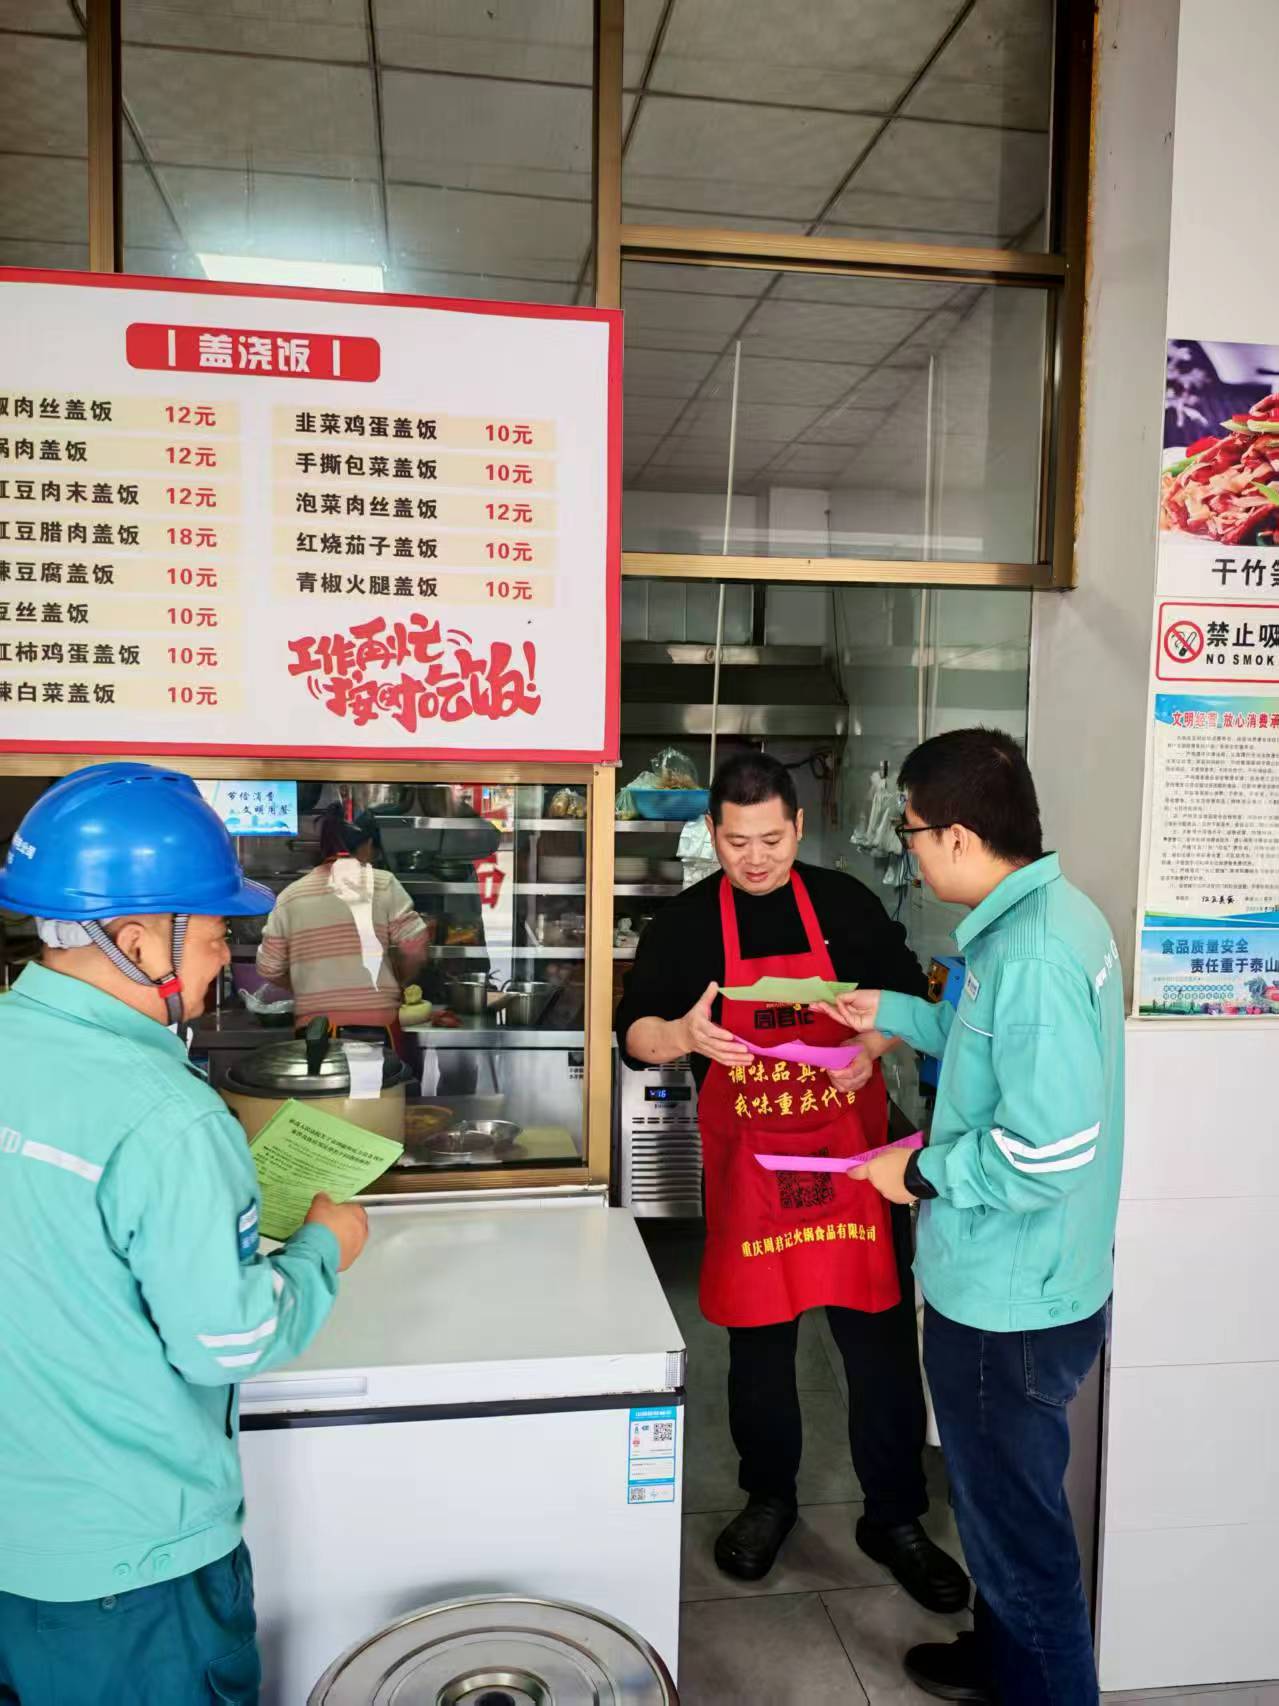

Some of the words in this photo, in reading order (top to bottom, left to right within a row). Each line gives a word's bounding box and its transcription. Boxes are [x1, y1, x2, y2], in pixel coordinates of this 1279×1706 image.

[197, 333, 312, 373] 盖浇饭
[165, 406, 216, 426] 12元
[296, 413, 436, 439] 韭菜鸡蛋盖饭
[485, 424, 533, 445] 10元
[167, 448, 217, 467] 12元
[296, 453, 436, 479] 手撕包菜盖饭
[485, 464, 533, 484] 10元
[167, 487, 216, 506] 12元
[296, 493, 437, 518] 泡菜肉丝盖饭
[485, 503, 533, 523] 12元
[167, 528, 215, 547] 18元
[297, 533, 437, 558] 红烧茄子盖饭
[485, 542, 533, 560] 10元
[166, 568, 216, 587] 10元
[297, 572, 437, 596] 青椒火腿盖饭
[485, 581, 533, 600] 10元
[168, 608, 216, 626] 10元
[1207, 621, 1279, 648] 禁止吸
[288, 612, 445, 677] 工作再忙
[167, 648, 217, 666] 10元
[1206, 653, 1225, 665] NO
[1233, 654, 1275, 666] SMOK
[167, 688, 218, 704] 10元
[1172, 712, 1217, 728] 文明经营
[1162, 938, 1249, 955] 食品质量安全
[1190, 957, 1279, 974] 责任重于泰山
[728, 1061, 825, 1085] 调味品真
[741, 1223, 877, 1257] 重庆周君记火锅食品有限公司
